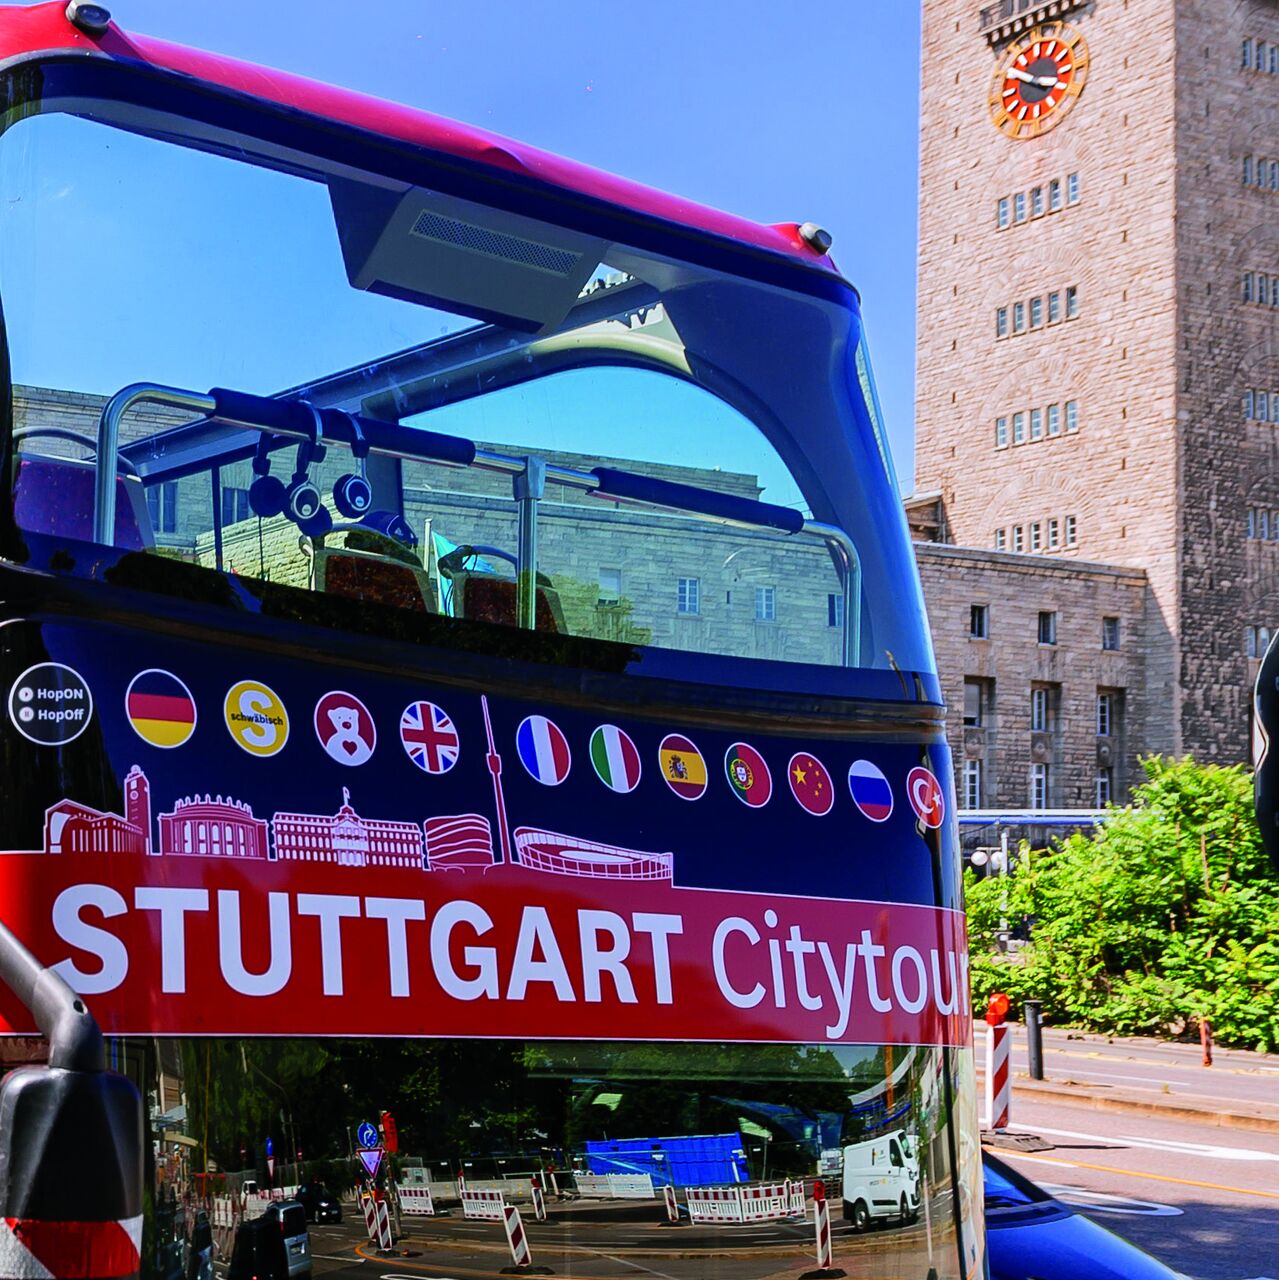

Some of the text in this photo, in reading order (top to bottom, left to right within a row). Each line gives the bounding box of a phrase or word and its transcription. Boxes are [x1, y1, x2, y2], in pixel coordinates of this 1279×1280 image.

[36, 687, 84, 701] HopON
[37, 708, 85, 723] HopOff
[230, 711, 284, 726] schwäbisch
[50, 883, 969, 1040] STUTTGART Citytour
